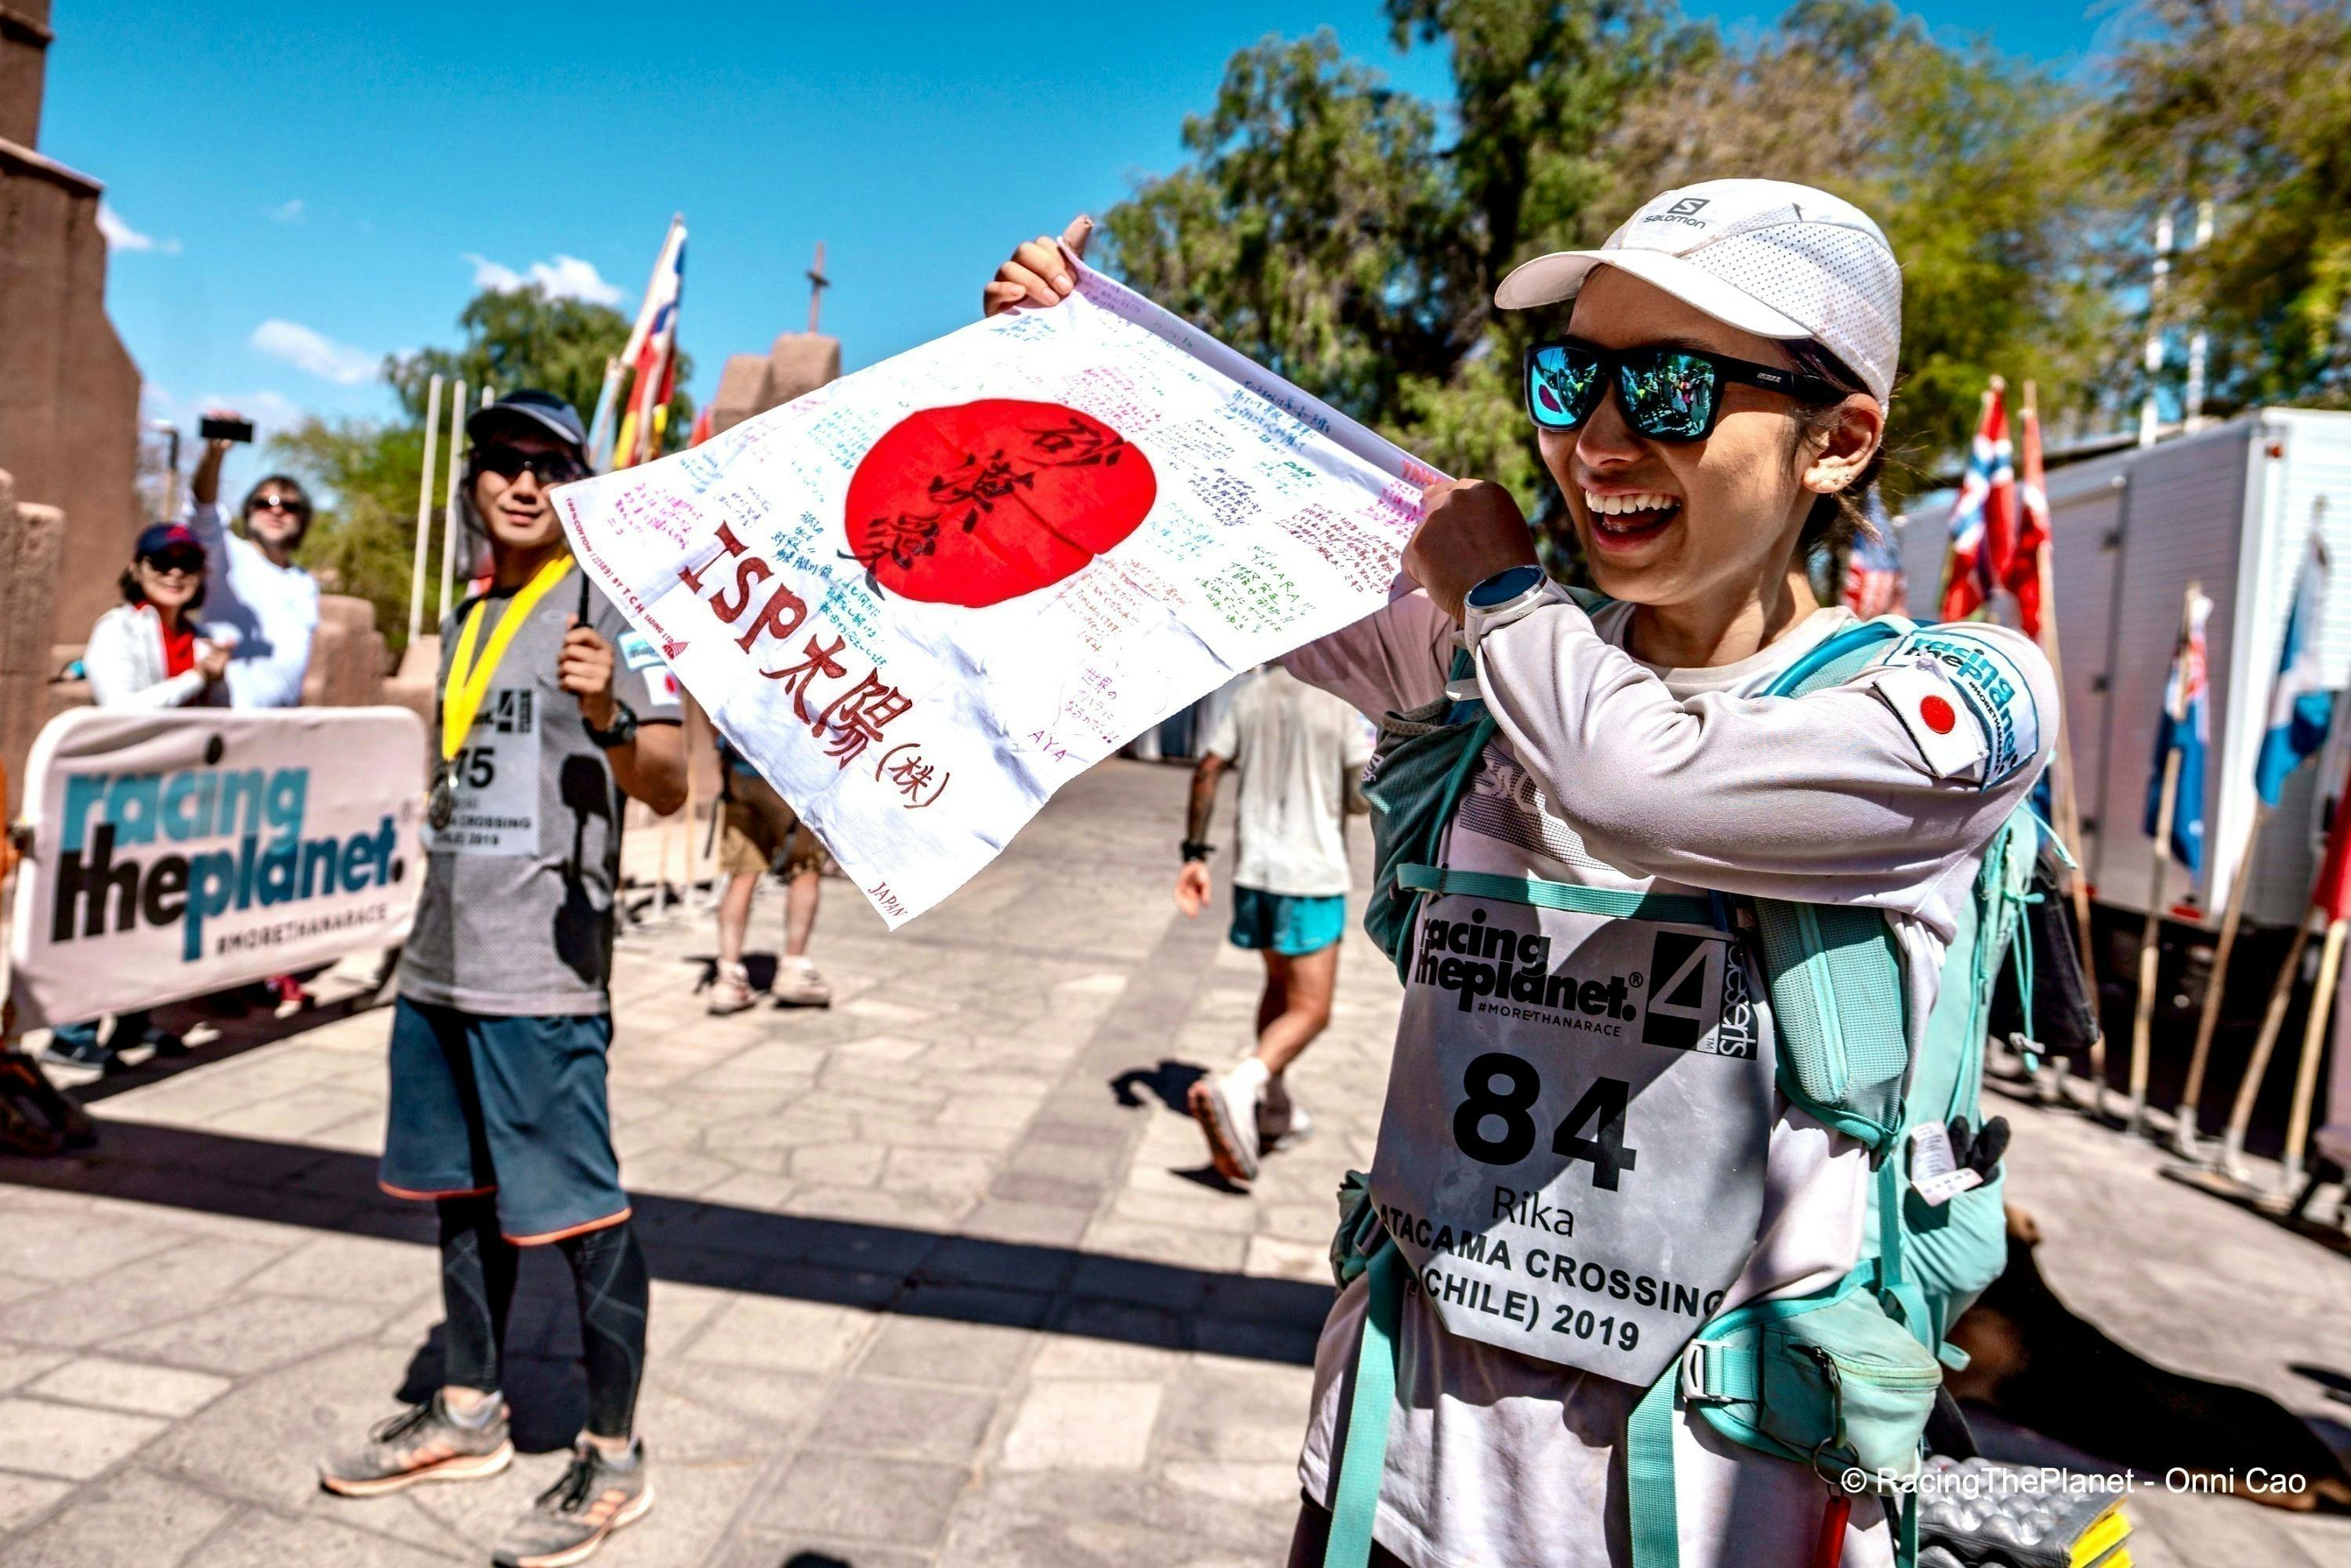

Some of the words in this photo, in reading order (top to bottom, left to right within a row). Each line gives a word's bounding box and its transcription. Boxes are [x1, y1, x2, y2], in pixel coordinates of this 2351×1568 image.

[1643, 214, 1707, 230] salomon
[1283, 462, 1317, 477] DAN
[611, 577, 623, 588] BY
[1027, 730, 1067, 762] AYA
[63, 734, 310, 852] racing
[868, 882, 907, 918] JAPAN
[1477, 1002, 1622, 1037] #MORETHANARACE
[1453, 1052, 1637, 1193] 84
[1492, 1186, 1575, 1238] Rika
[1379, 1203, 1512, 1271] ATACAMA
[1418, 1263, 1541, 1332] (CHILE)
[1552, 1303, 1640, 1352] 2019
